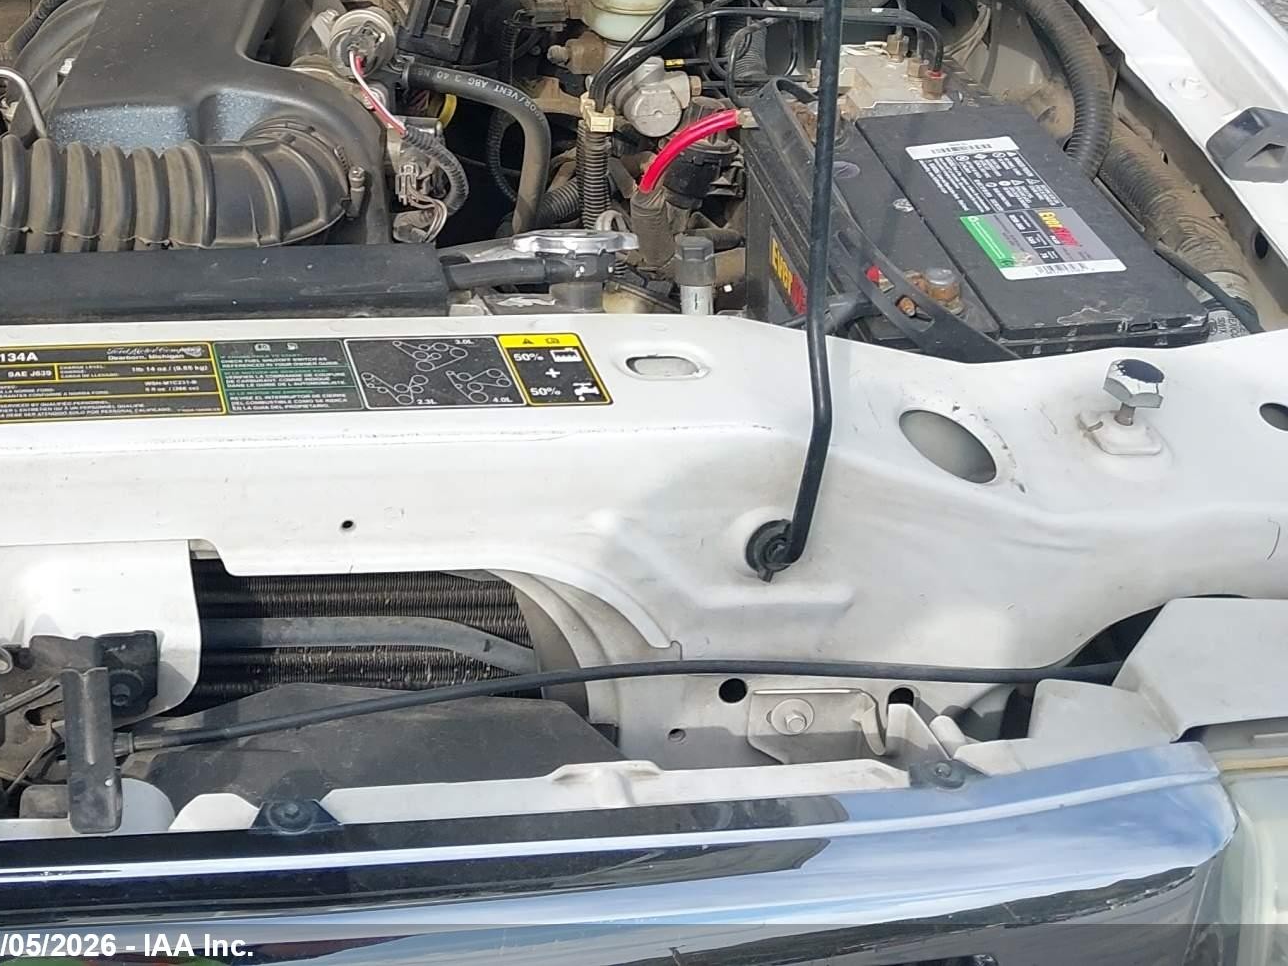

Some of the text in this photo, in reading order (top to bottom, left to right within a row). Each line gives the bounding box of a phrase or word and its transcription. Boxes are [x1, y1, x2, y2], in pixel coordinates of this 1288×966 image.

[513, 353, 544, 362] 50%
[8, 369, 52, 378] SAE J639
[530, 387, 561, 396] 50%
